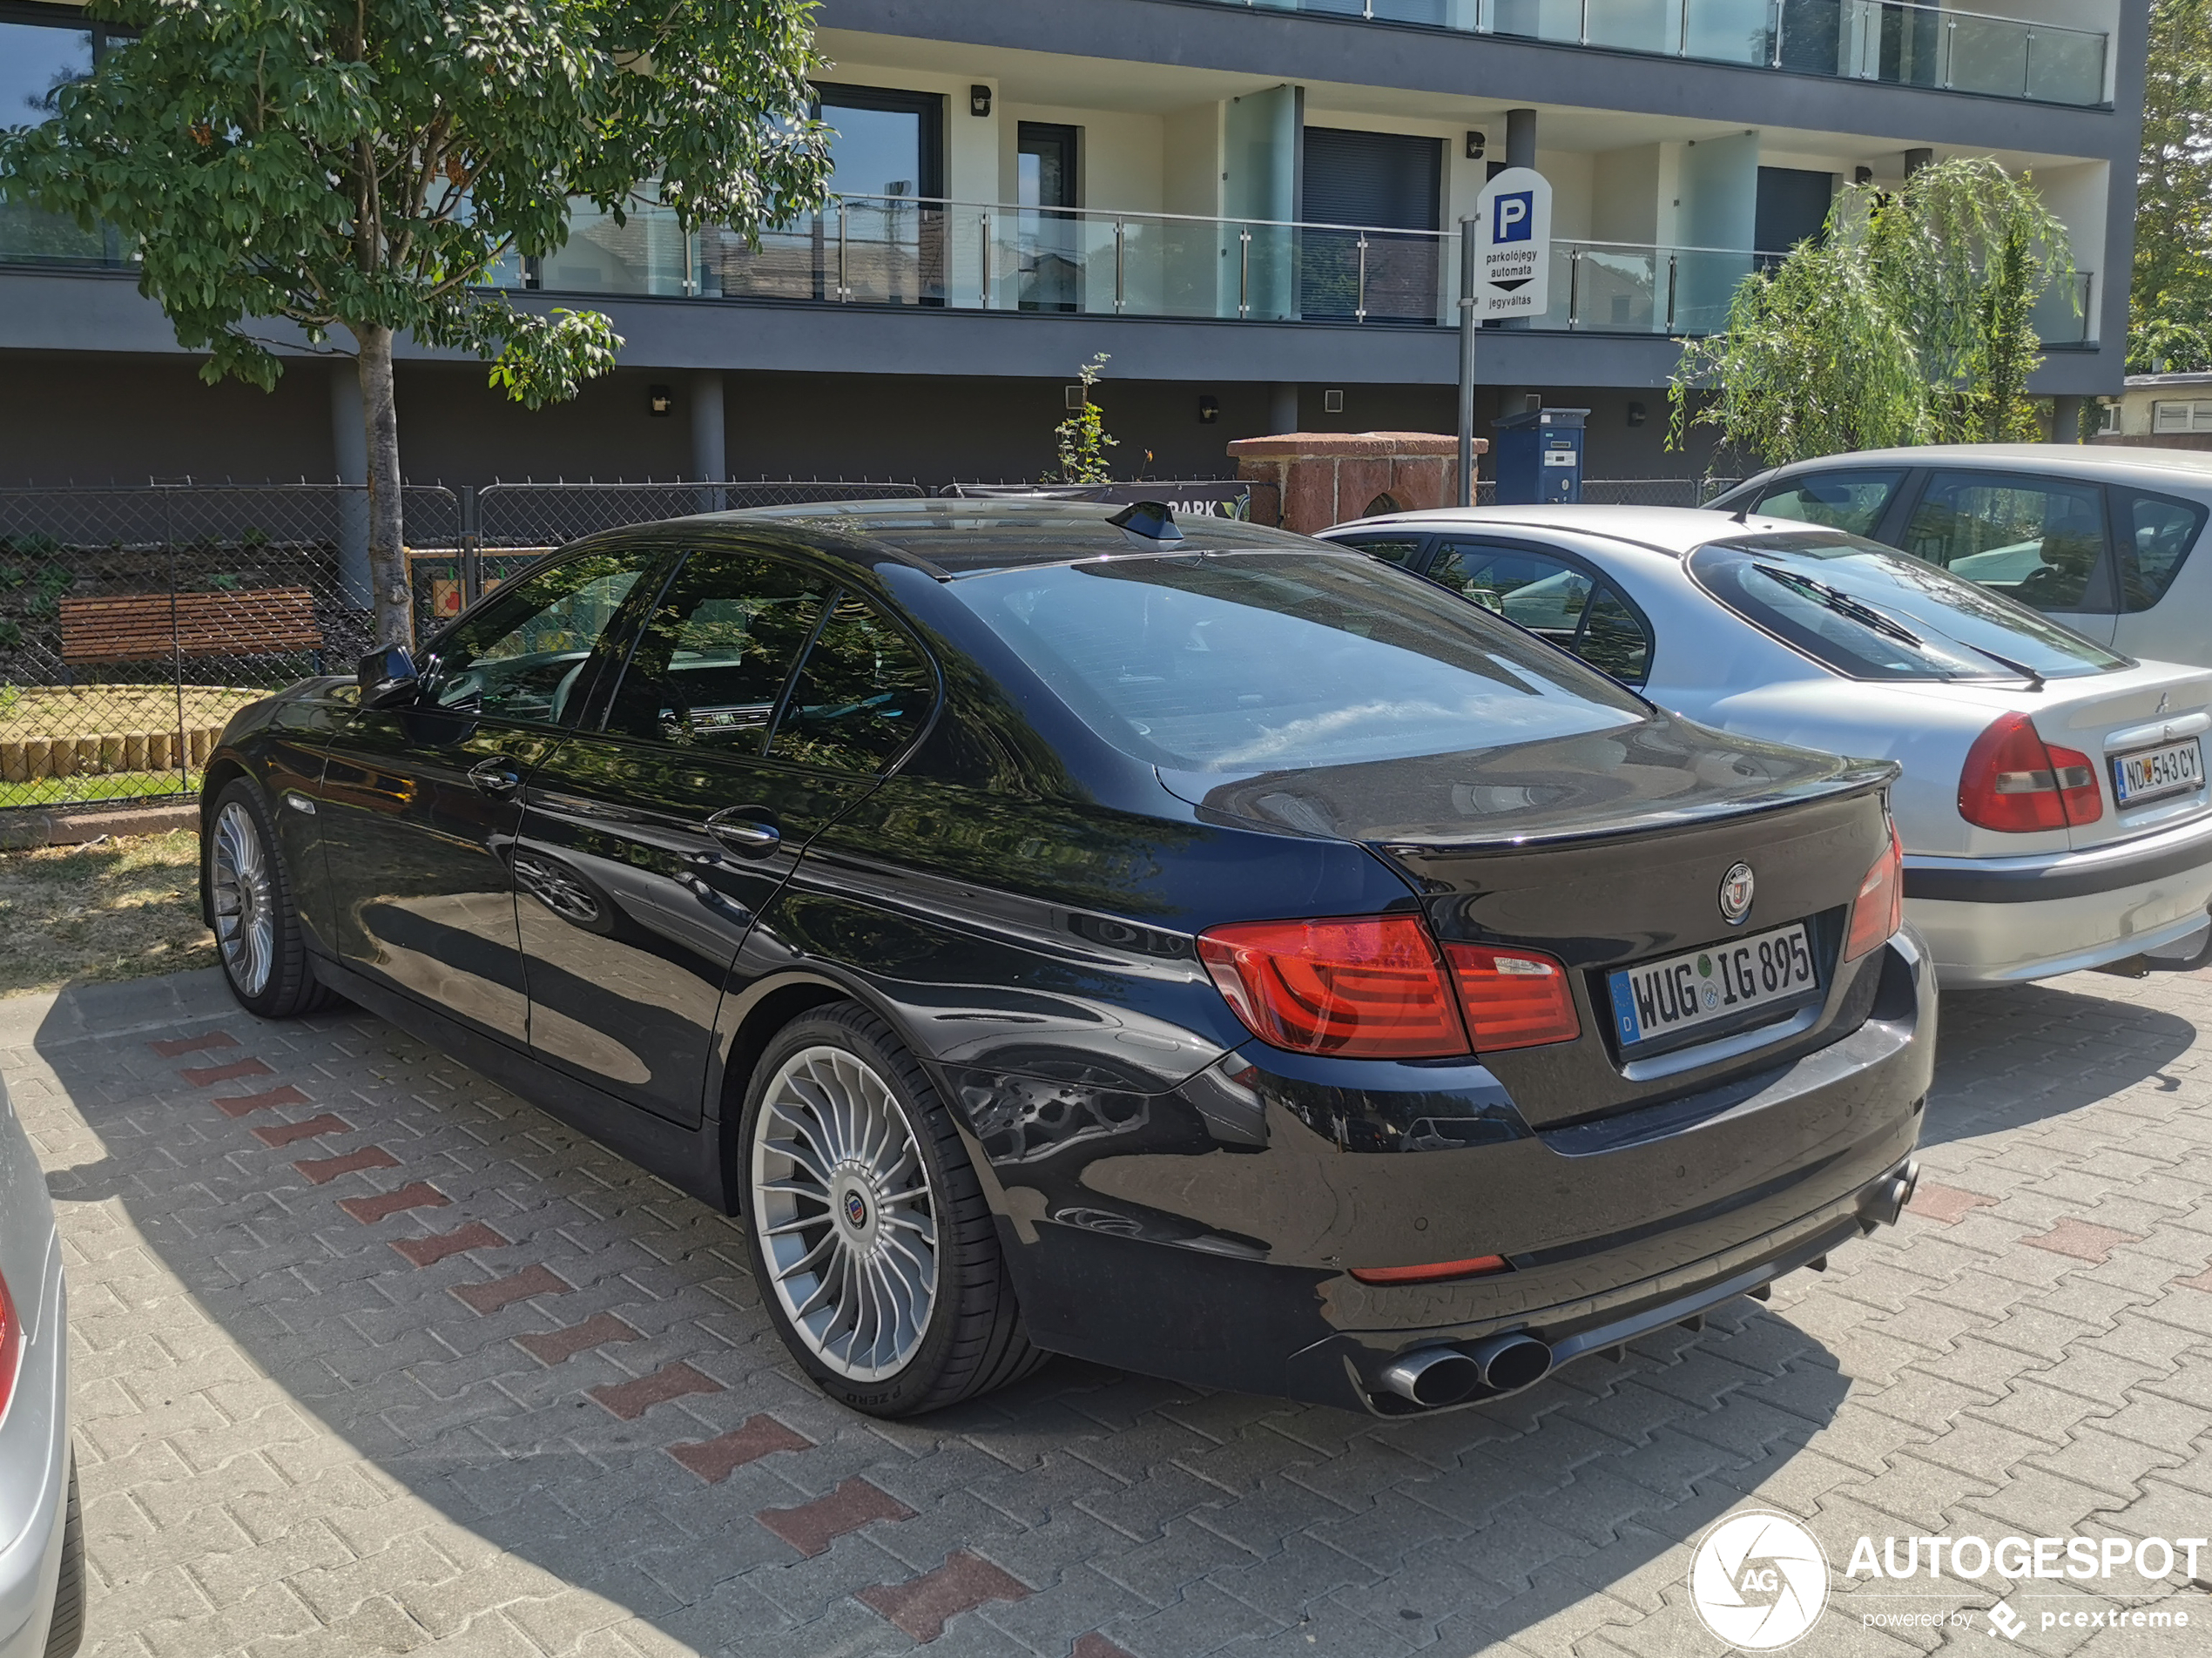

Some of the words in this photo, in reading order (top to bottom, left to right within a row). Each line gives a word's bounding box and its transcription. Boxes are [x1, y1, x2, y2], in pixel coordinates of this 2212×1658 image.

[1500, 199, 1526, 239] P
[1487, 250, 1537, 265] parkolójegy
[1491, 266, 1532, 277] automata
[1489, 295, 1531, 309] jegyváltás
[2126, 760, 2144, 792] ND
[2152, 752, 2178, 785] 543
[2179, 747, 2196, 778] CY
[1632, 963, 1699, 1029] WUG
[1718, 947, 1757, 1006] IG
[1758, 932, 1810, 993] 895
[1622, 1017, 1632, 1032] D
[846, 1392, 889, 1405] ZERO
